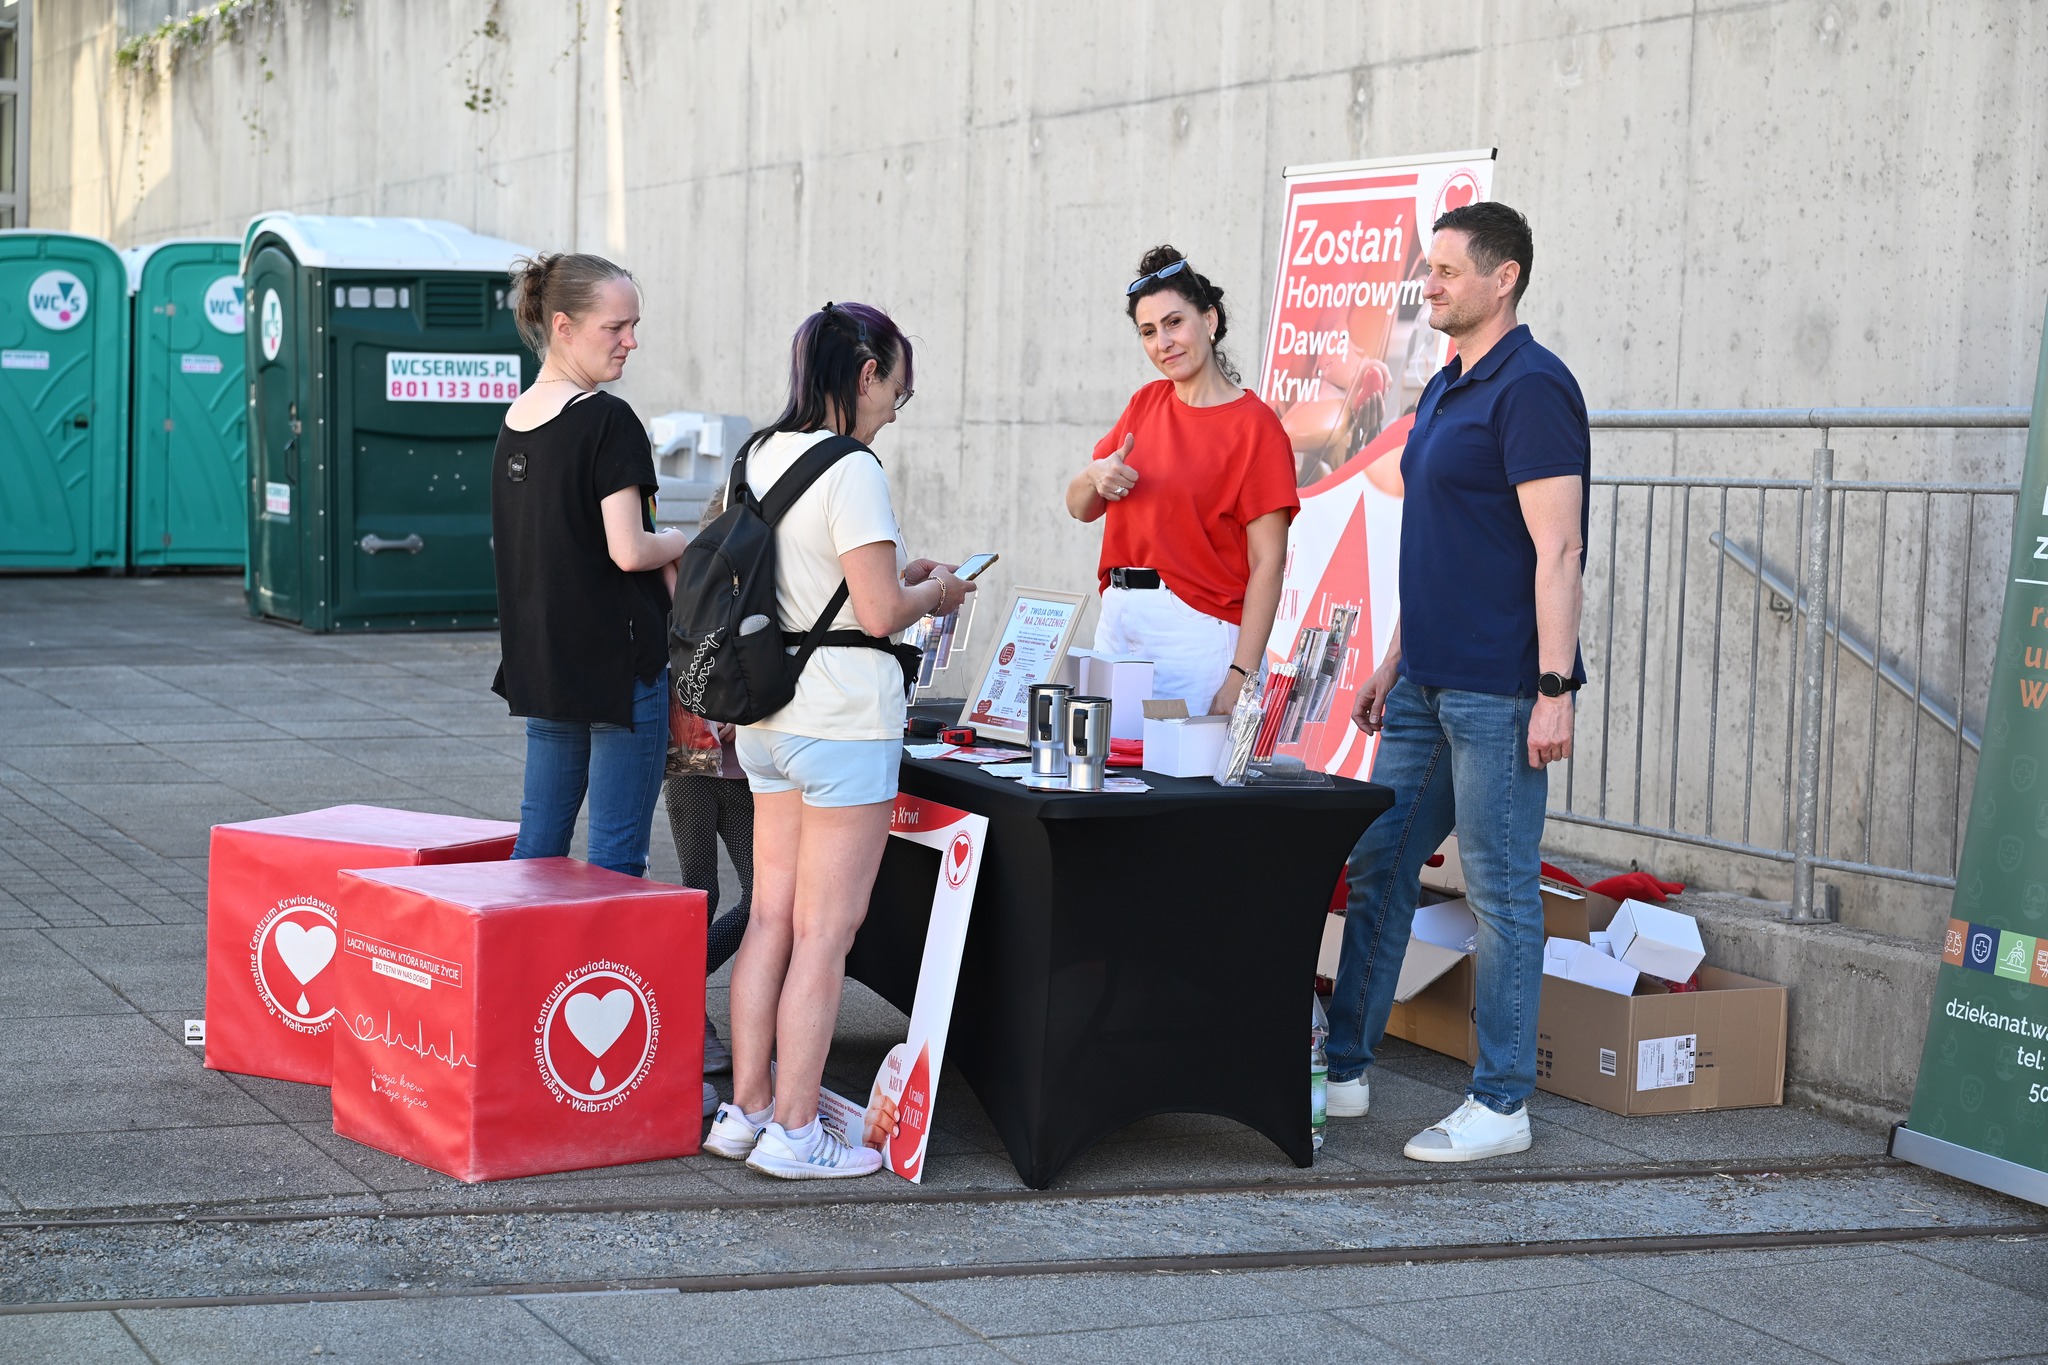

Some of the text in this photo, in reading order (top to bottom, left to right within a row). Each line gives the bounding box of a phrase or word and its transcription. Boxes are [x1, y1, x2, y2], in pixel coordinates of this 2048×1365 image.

[1292, 214, 1403, 266] Zostań
[1286, 276, 1425, 315] Honorowym
[1278, 322, 1350, 363] Dawcą
[391, 359, 517, 378] WCSERWIS.PL
[1270, 369, 1323, 402] Krwi
[391, 381, 518, 399] 801 133 088
[898, 806, 920, 825] Krwi
[249, 907, 278, 951] Centrum
[347, 936, 459, 980] ŁĄCZY NAS KREW, KTÓRA RATUJE ŻYCIE
[375, 961, 383, 970] BO
[402, 969, 413, 980] NAS
[412, 973, 429, 986] DOBRO
[249, 953, 277, 1016] Regionalne
[282, 1013, 329, 1036] Wałbrzych
[533, 958, 662, 1103] Regionalne Centrum Krwiodawstwa i Krwiolecznictwa
[1945, 998, 2048, 1042] dziekanat.w
[2017, 1046, 2046, 1071] tel:
[571, 1092, 627, 1113] Wałbrzych
